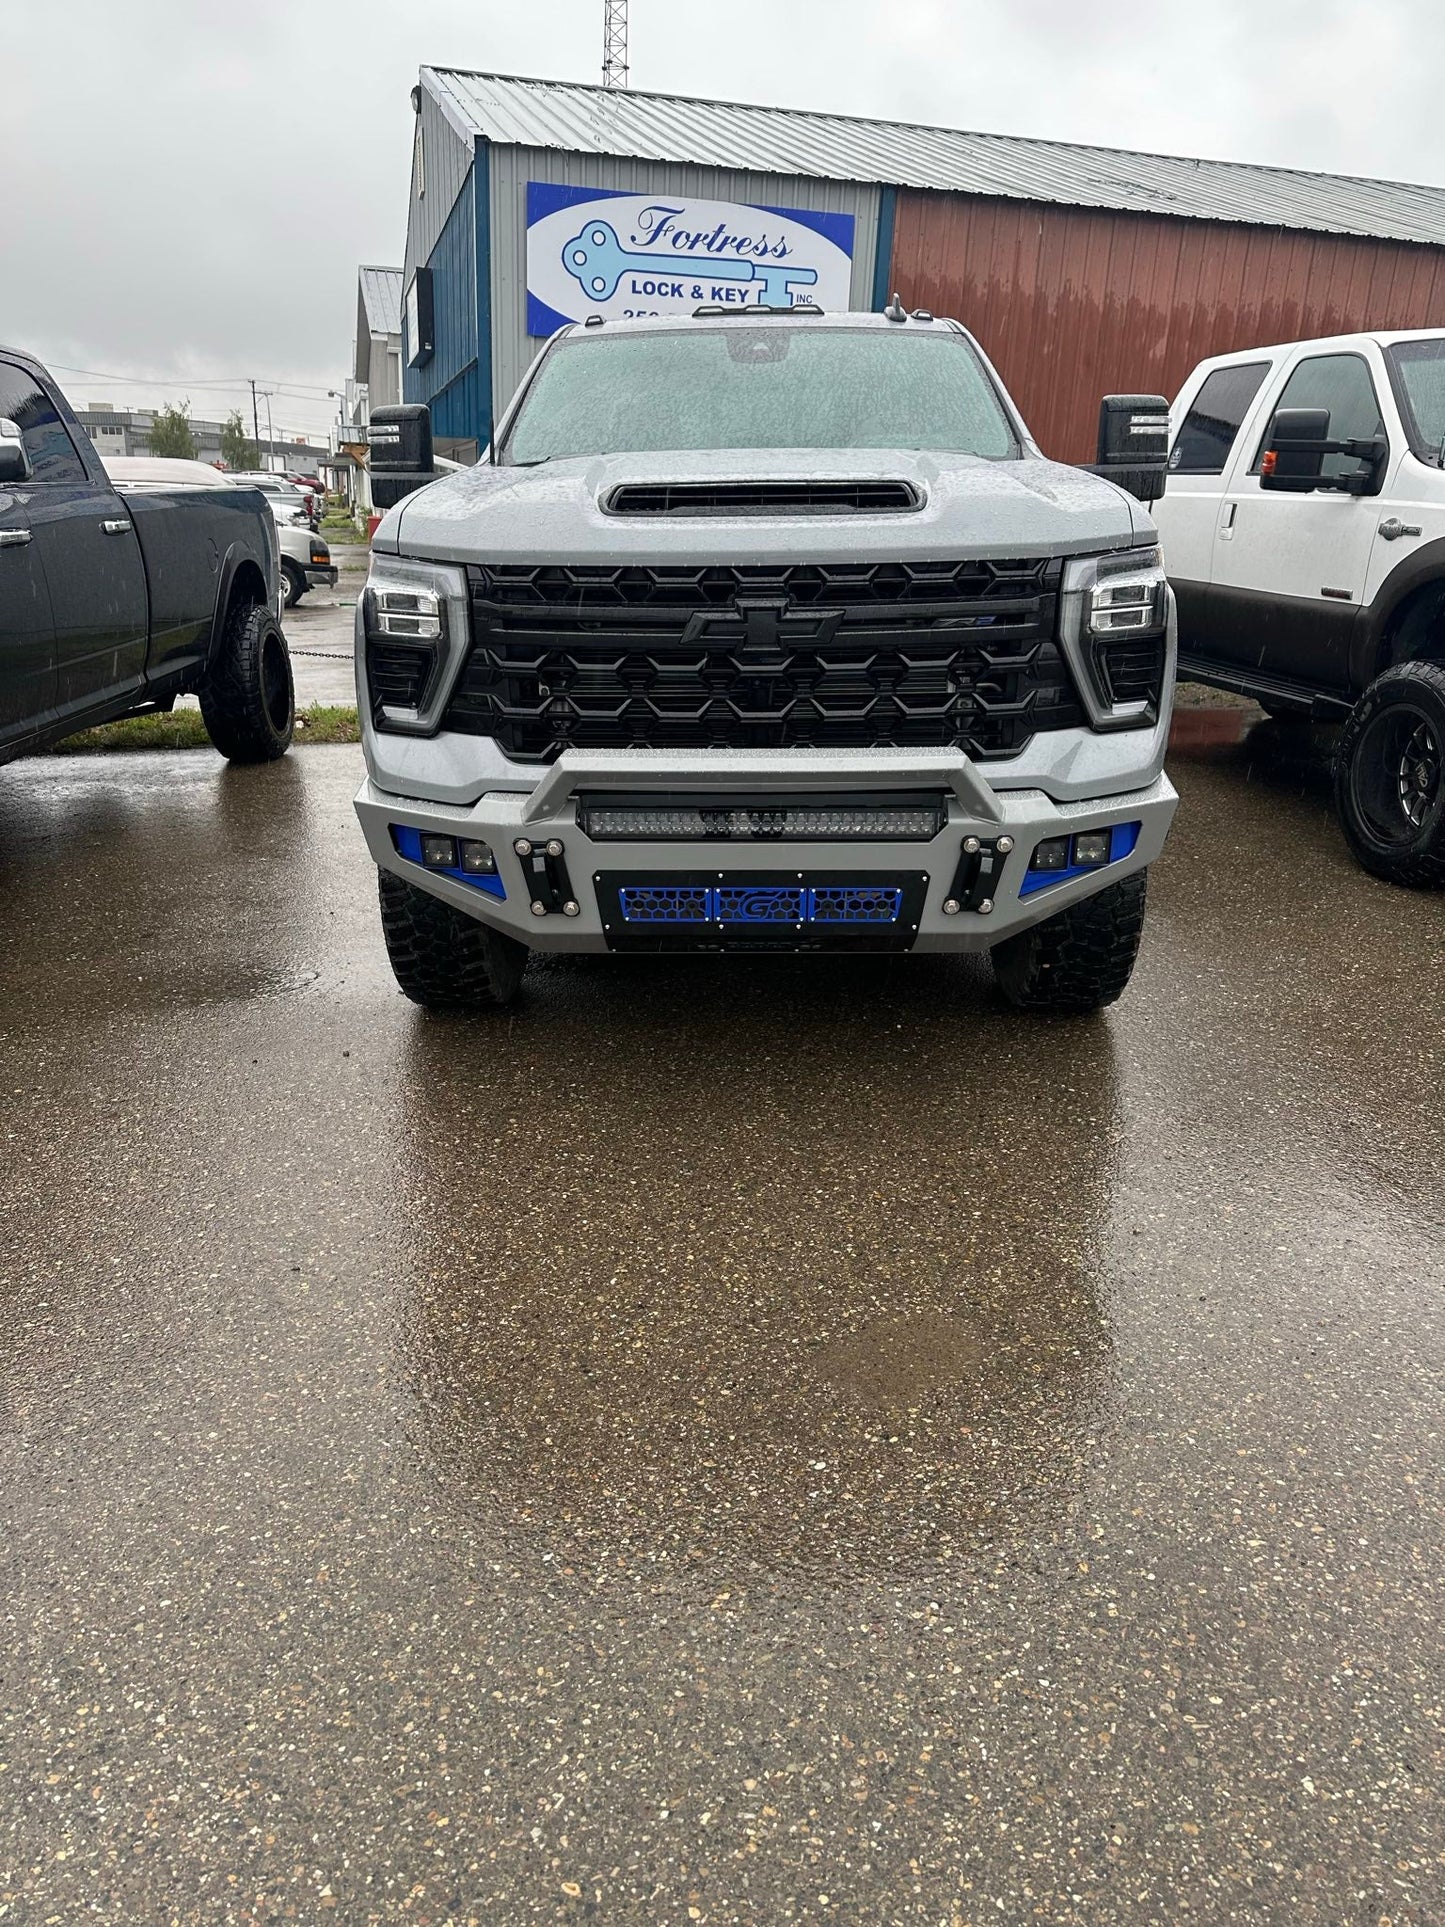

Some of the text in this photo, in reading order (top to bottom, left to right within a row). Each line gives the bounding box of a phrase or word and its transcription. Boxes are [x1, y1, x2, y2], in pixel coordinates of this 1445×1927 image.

[630, 205, 793, 258] Fortress
[631, 280, 813, 304] LOCK & KEY INC
